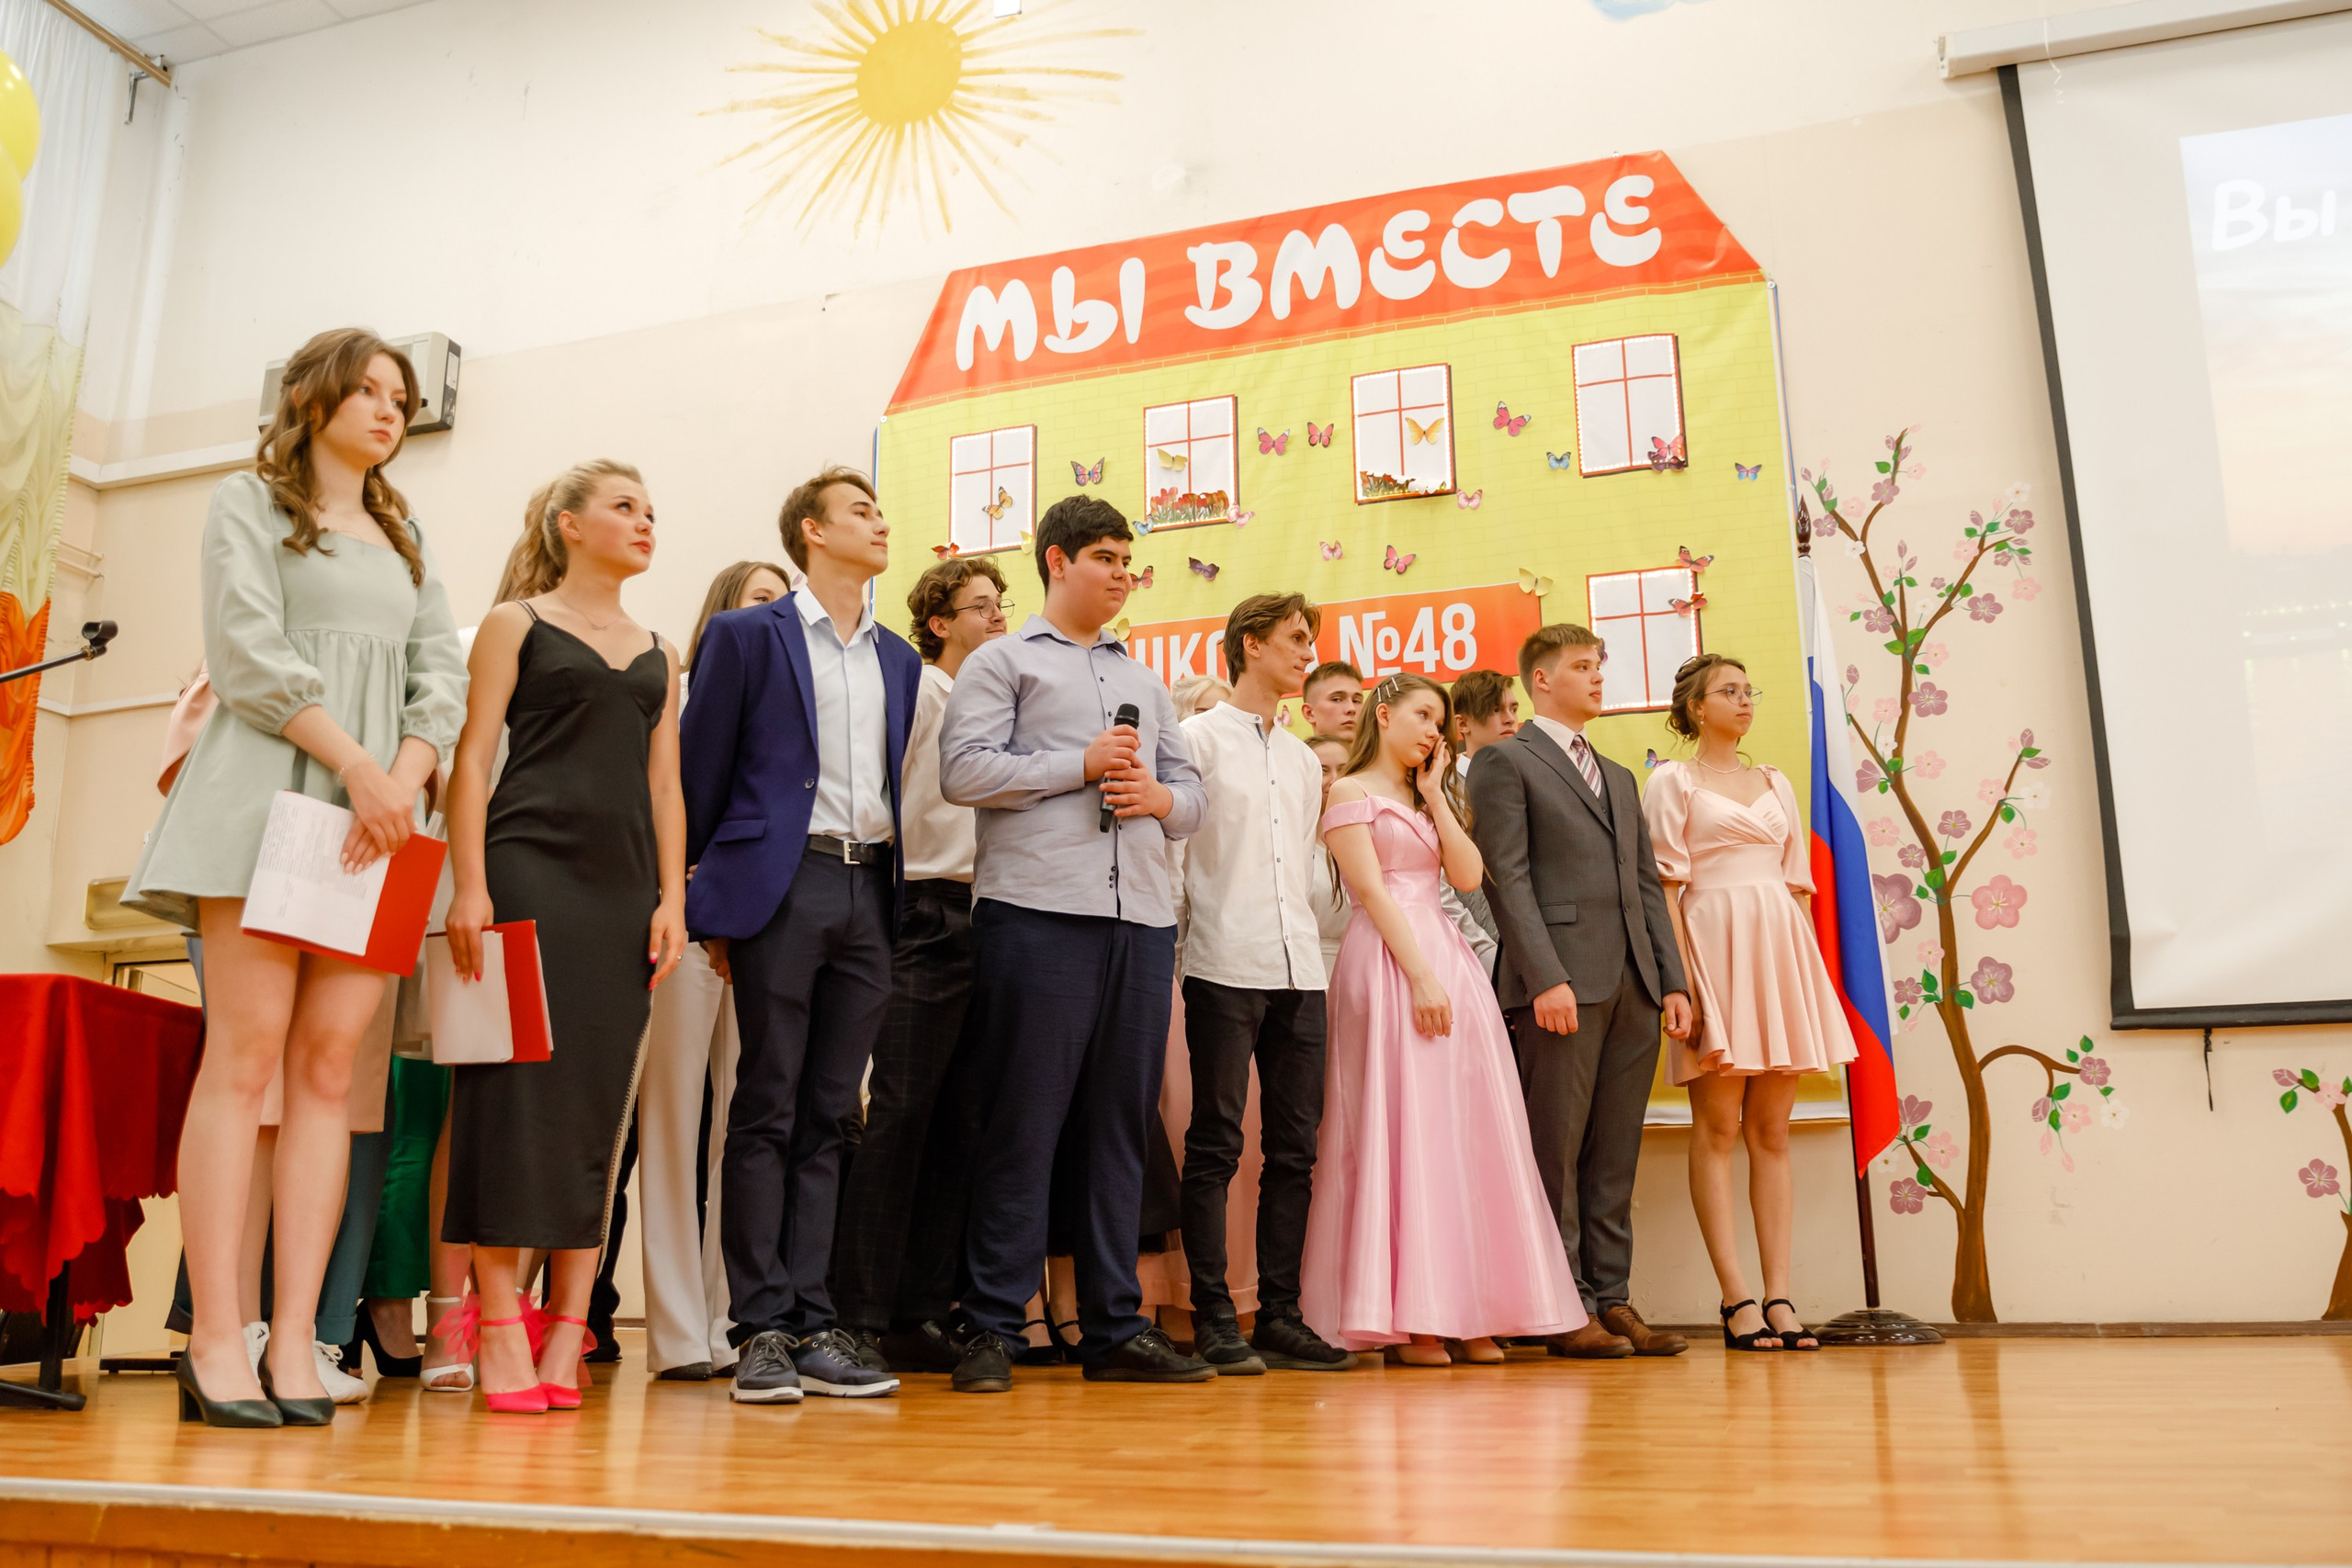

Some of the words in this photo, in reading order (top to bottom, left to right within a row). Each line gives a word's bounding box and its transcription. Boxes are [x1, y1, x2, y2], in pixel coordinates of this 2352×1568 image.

[956, 257, 1148, 371] МЫ
[1184, 175, 1662, 330] ВМЕСТЕ
[1339, 603, 1477, 679] №48
